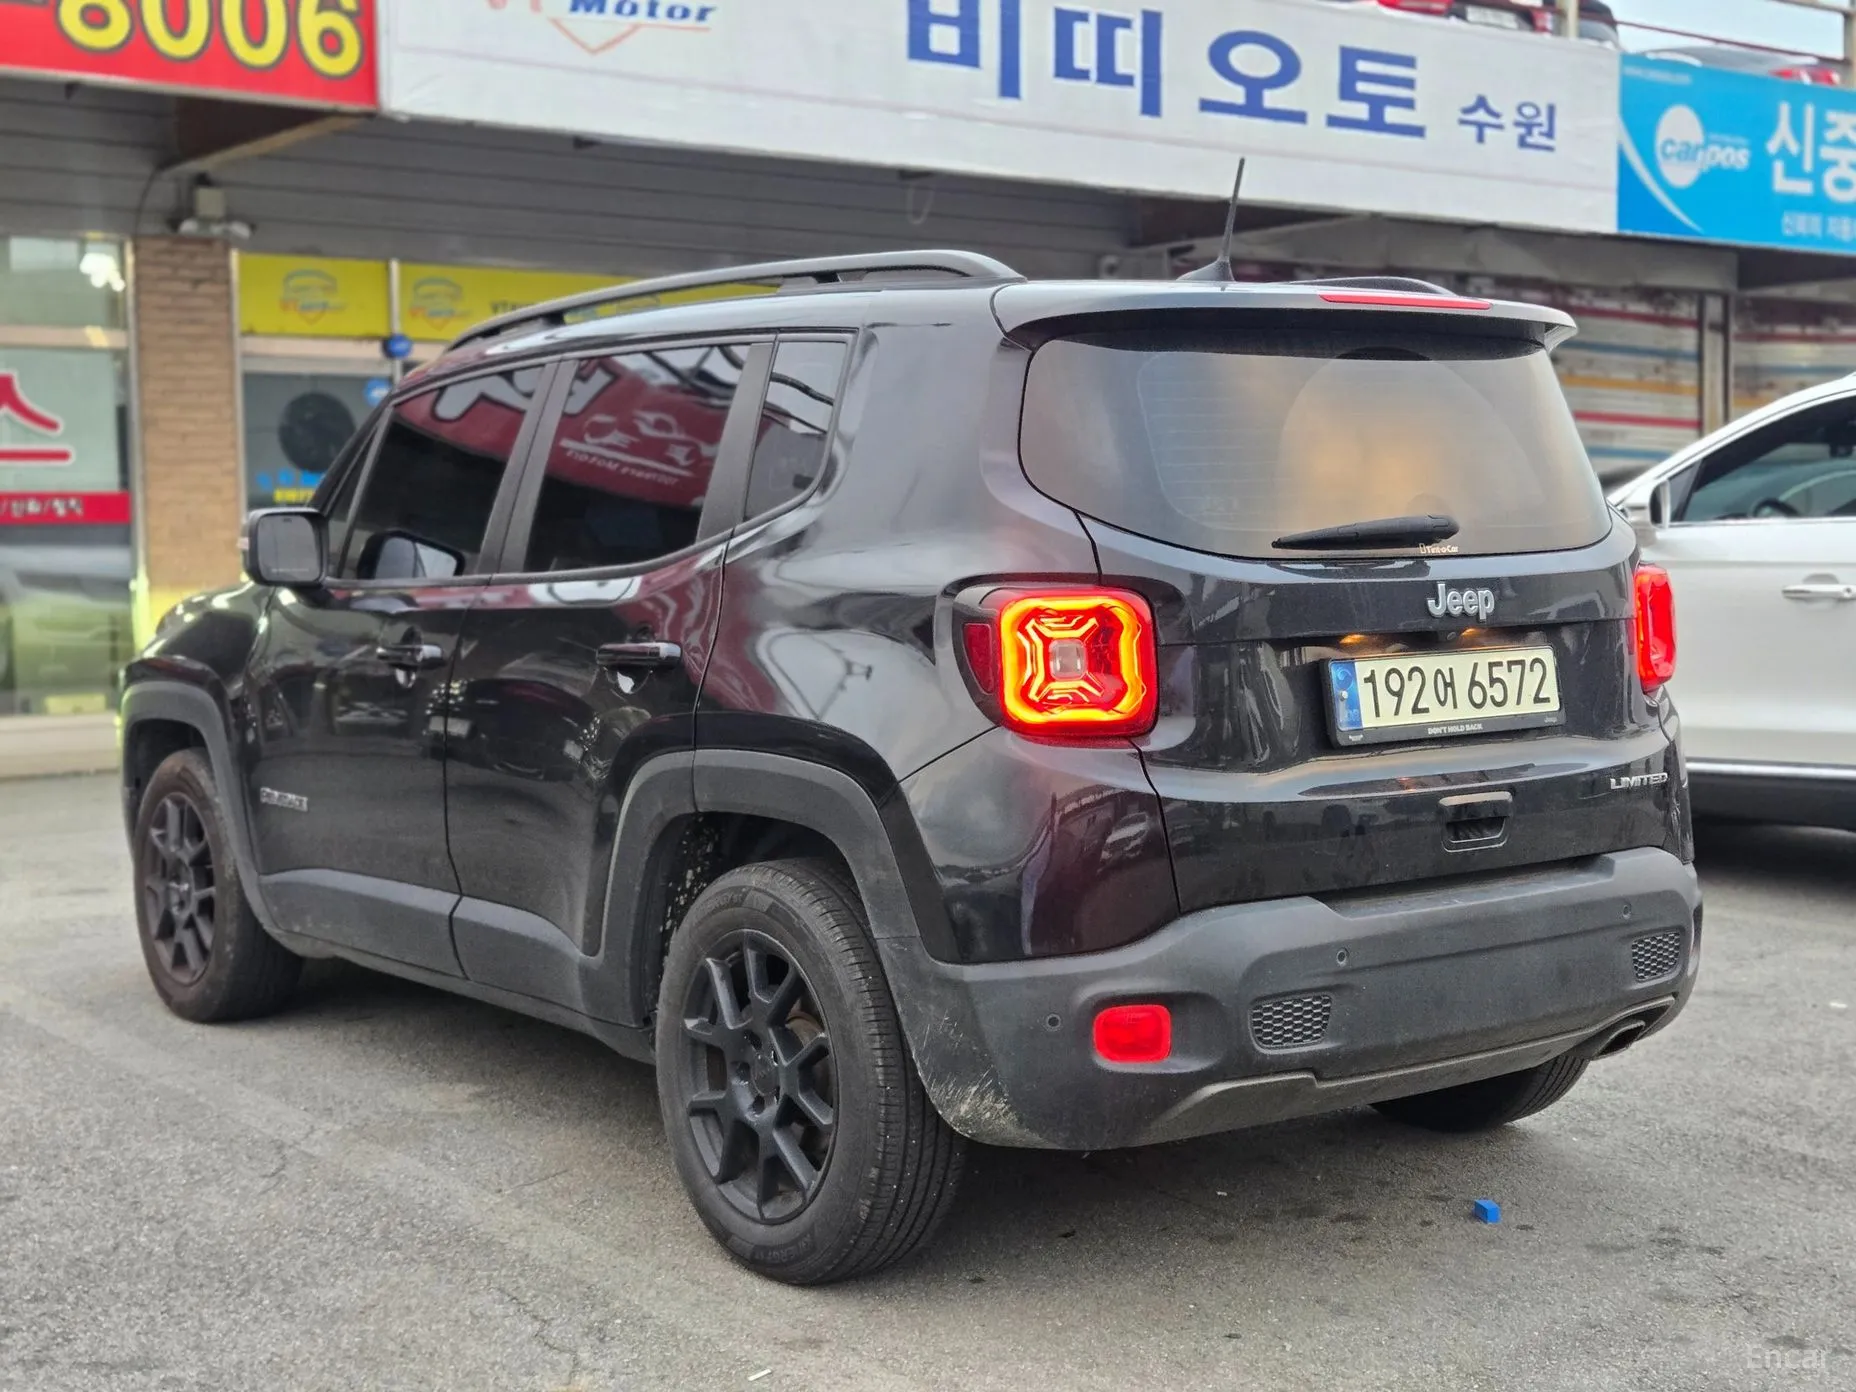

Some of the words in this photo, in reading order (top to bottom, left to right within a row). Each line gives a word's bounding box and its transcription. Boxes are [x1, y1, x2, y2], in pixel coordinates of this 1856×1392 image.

[1458, 94, 1555, 152] 수원
[1427, 582, 1495, 621] Jeep
[1363, 666, 1459, 718] 192어
[1467, 657, 1551, 709] 6572
[1610, 772, 1668, 790] LIMITED
